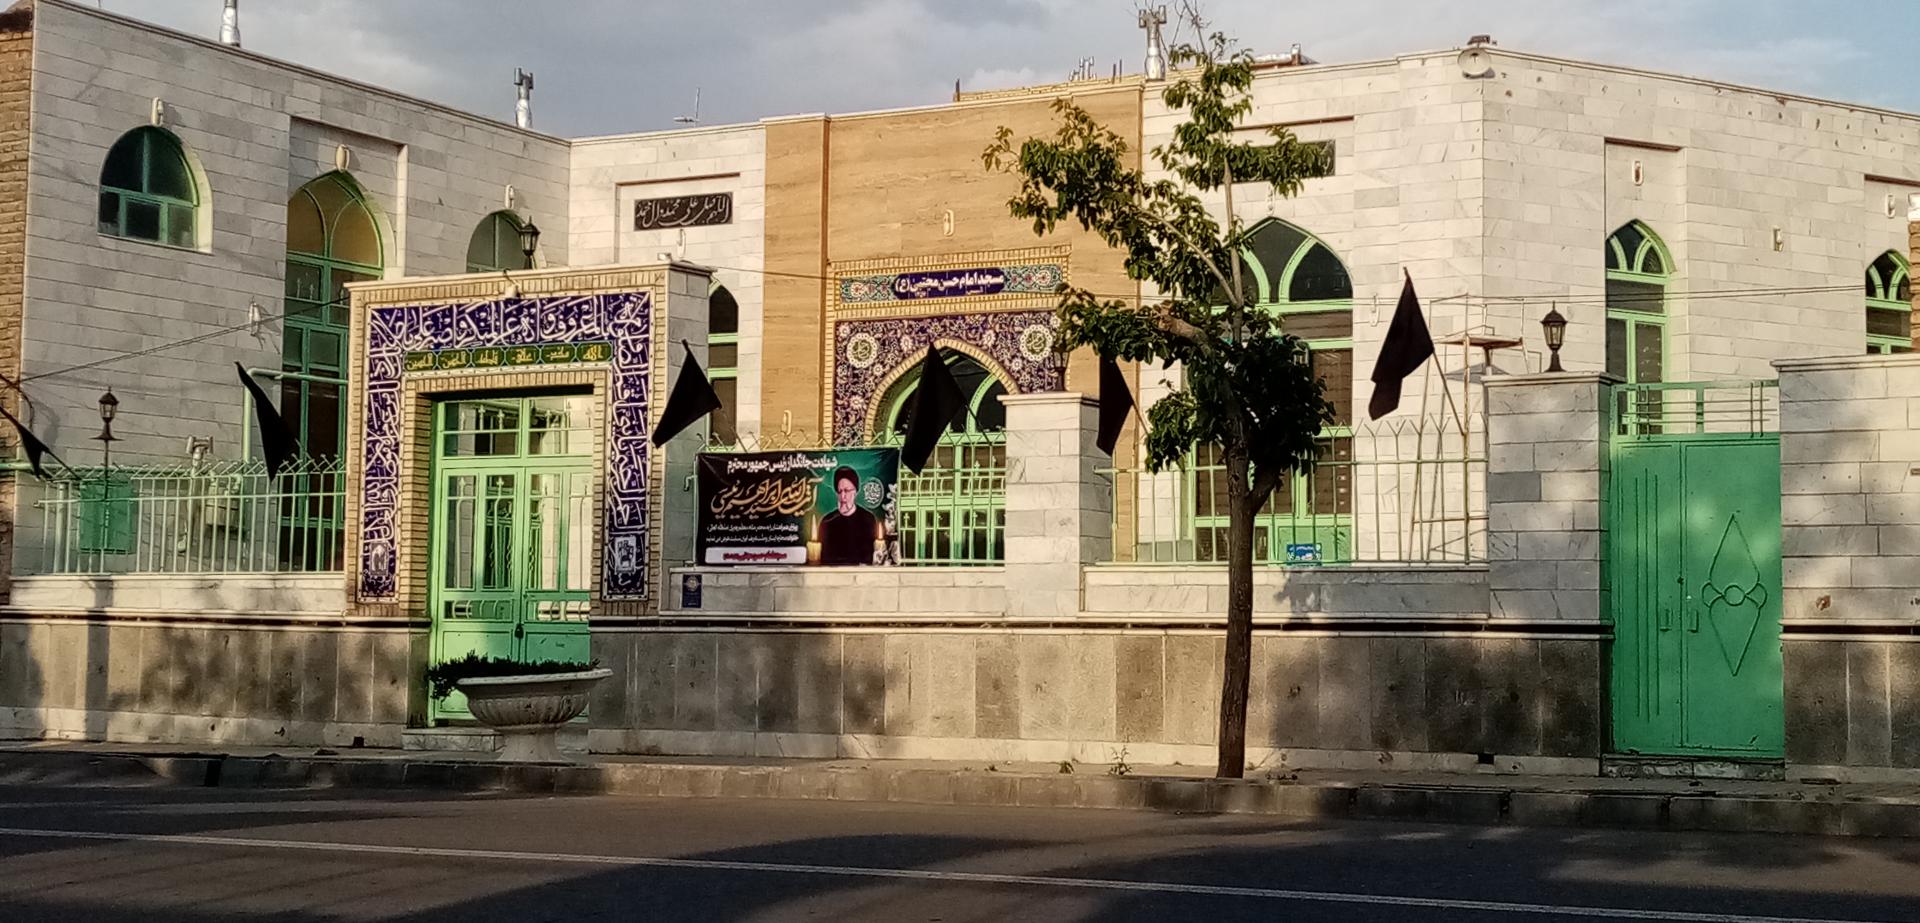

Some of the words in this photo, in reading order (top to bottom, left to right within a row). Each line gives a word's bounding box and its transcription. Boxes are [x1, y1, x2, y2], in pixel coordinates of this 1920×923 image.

[895, 277, 911, 293] (ع)
[938, 277, 960, 292] حسن
[959, 271, 978, 290] امام
[977, 273, 1005, 288] مسجد
[727, 457, 748, 475] محترم
[747, 459, 770, 473] جمهور
[768, 455, 787, 473] رئیس
[810, 453, 838, 471] شهادت
